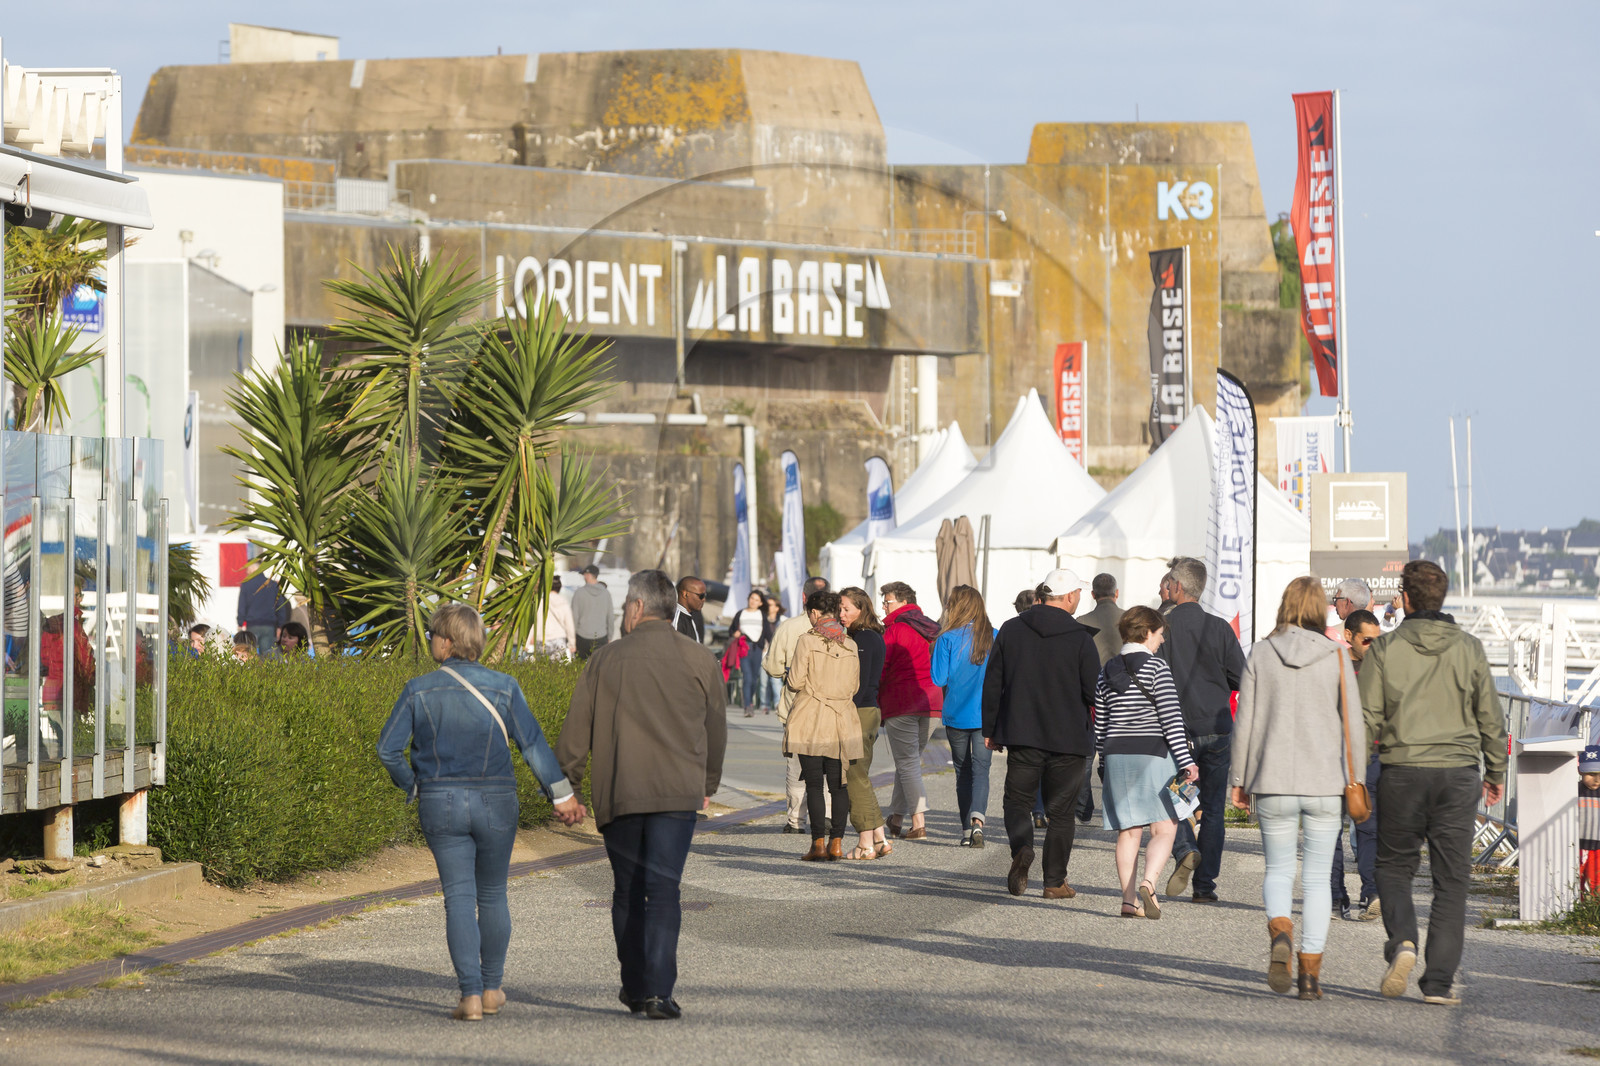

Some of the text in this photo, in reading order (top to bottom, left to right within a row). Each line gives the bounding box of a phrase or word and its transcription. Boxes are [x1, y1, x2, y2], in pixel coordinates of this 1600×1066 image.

[1157, 181, 1213, 221] K3
[1304, 148, 1333, 335] LA BASE
[495, 254, 864, 338] LORIENT LA BASE
[1160, 287, 1183, 424] LA BASE
[1061, 370, 1081, 431] BASE
